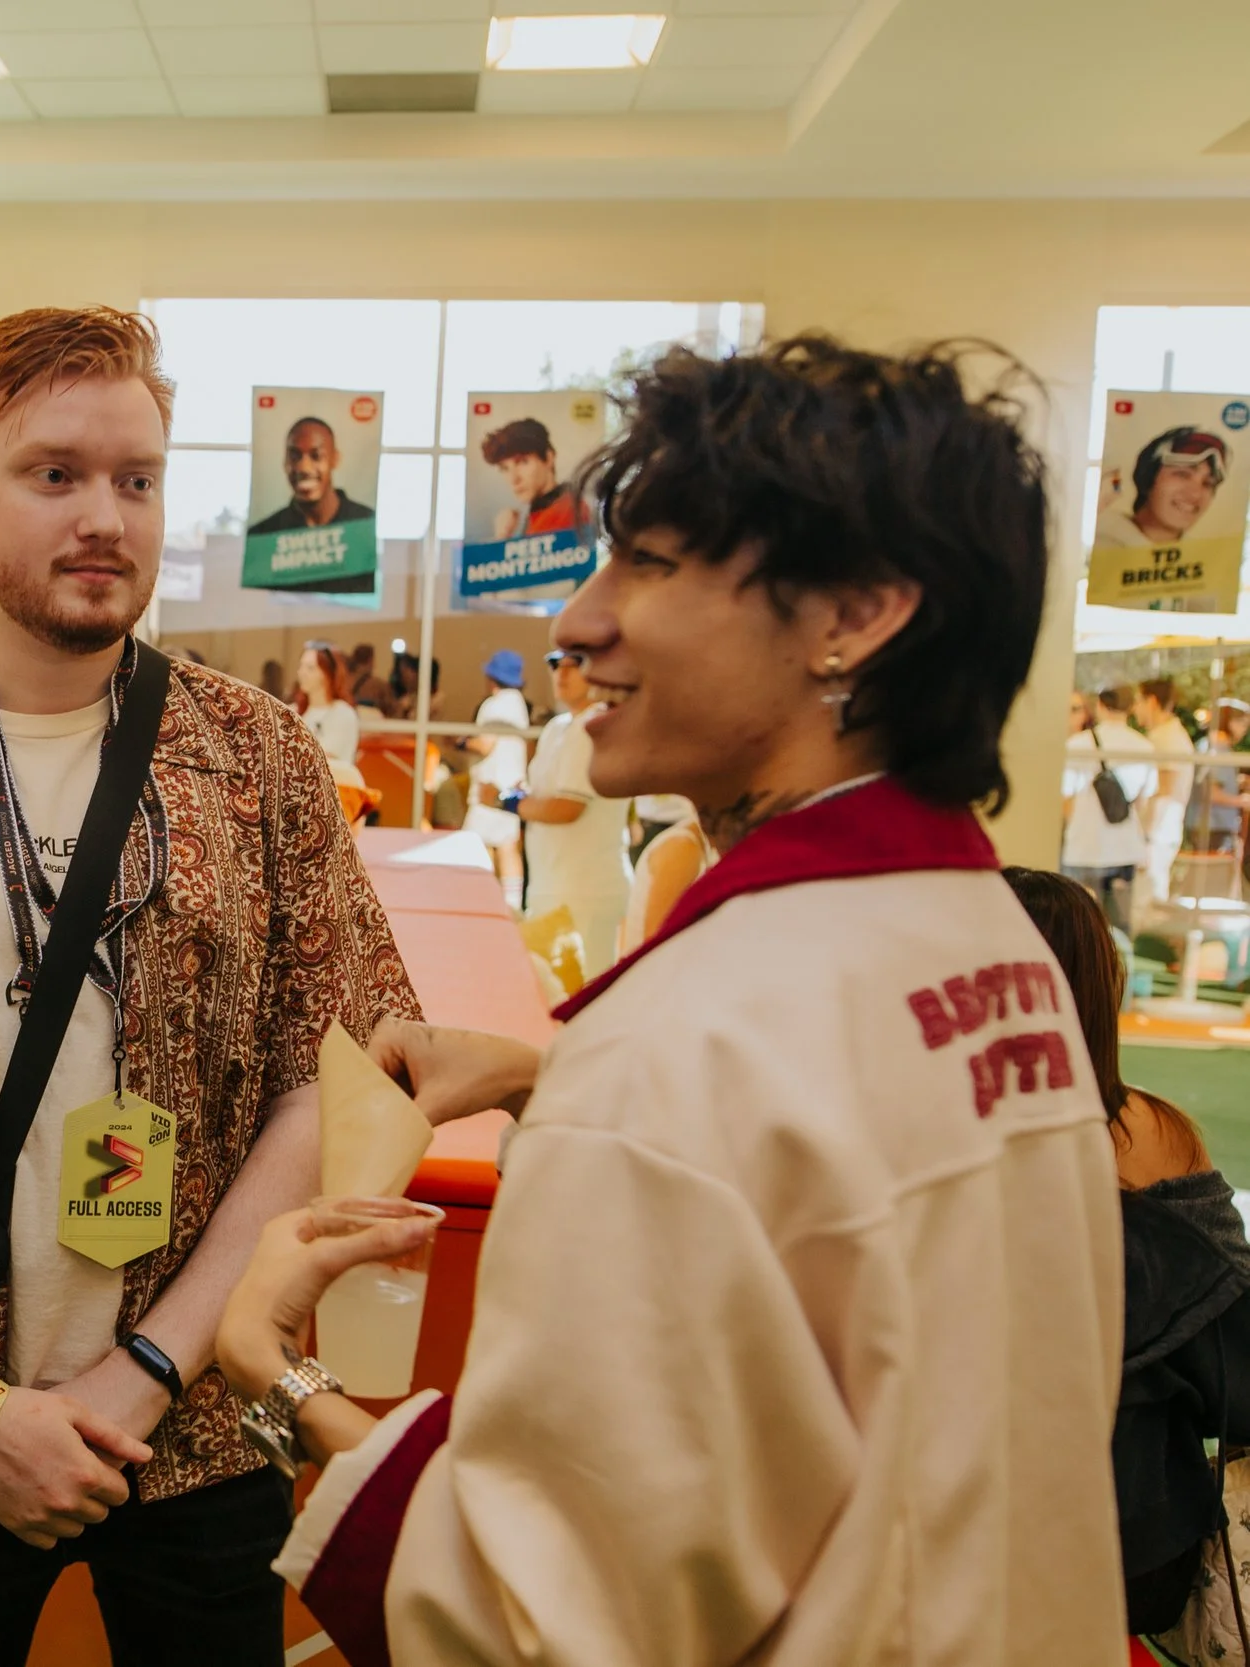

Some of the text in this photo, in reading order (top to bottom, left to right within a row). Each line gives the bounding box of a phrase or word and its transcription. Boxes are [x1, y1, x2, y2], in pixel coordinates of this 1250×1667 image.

[276, 527, 346, 553] SWEET
[503, 534, 557, 560] PEET
[271, 544, 349, 572] IMPACT
[467, 546, 590, 583] MONTZINGO
[1152, 547, 1181, 564] TD
[1121, 562, 1204, 586] BRICKS
[3, 840, 17, 876] JAGGED
[156, 844, 164, 880] JAGGED
[151, 1111, 171, 1128] VID
[148, 1127, 171, 1145] CON
[68, 1200, 162, 1217] FULL ACCESS
